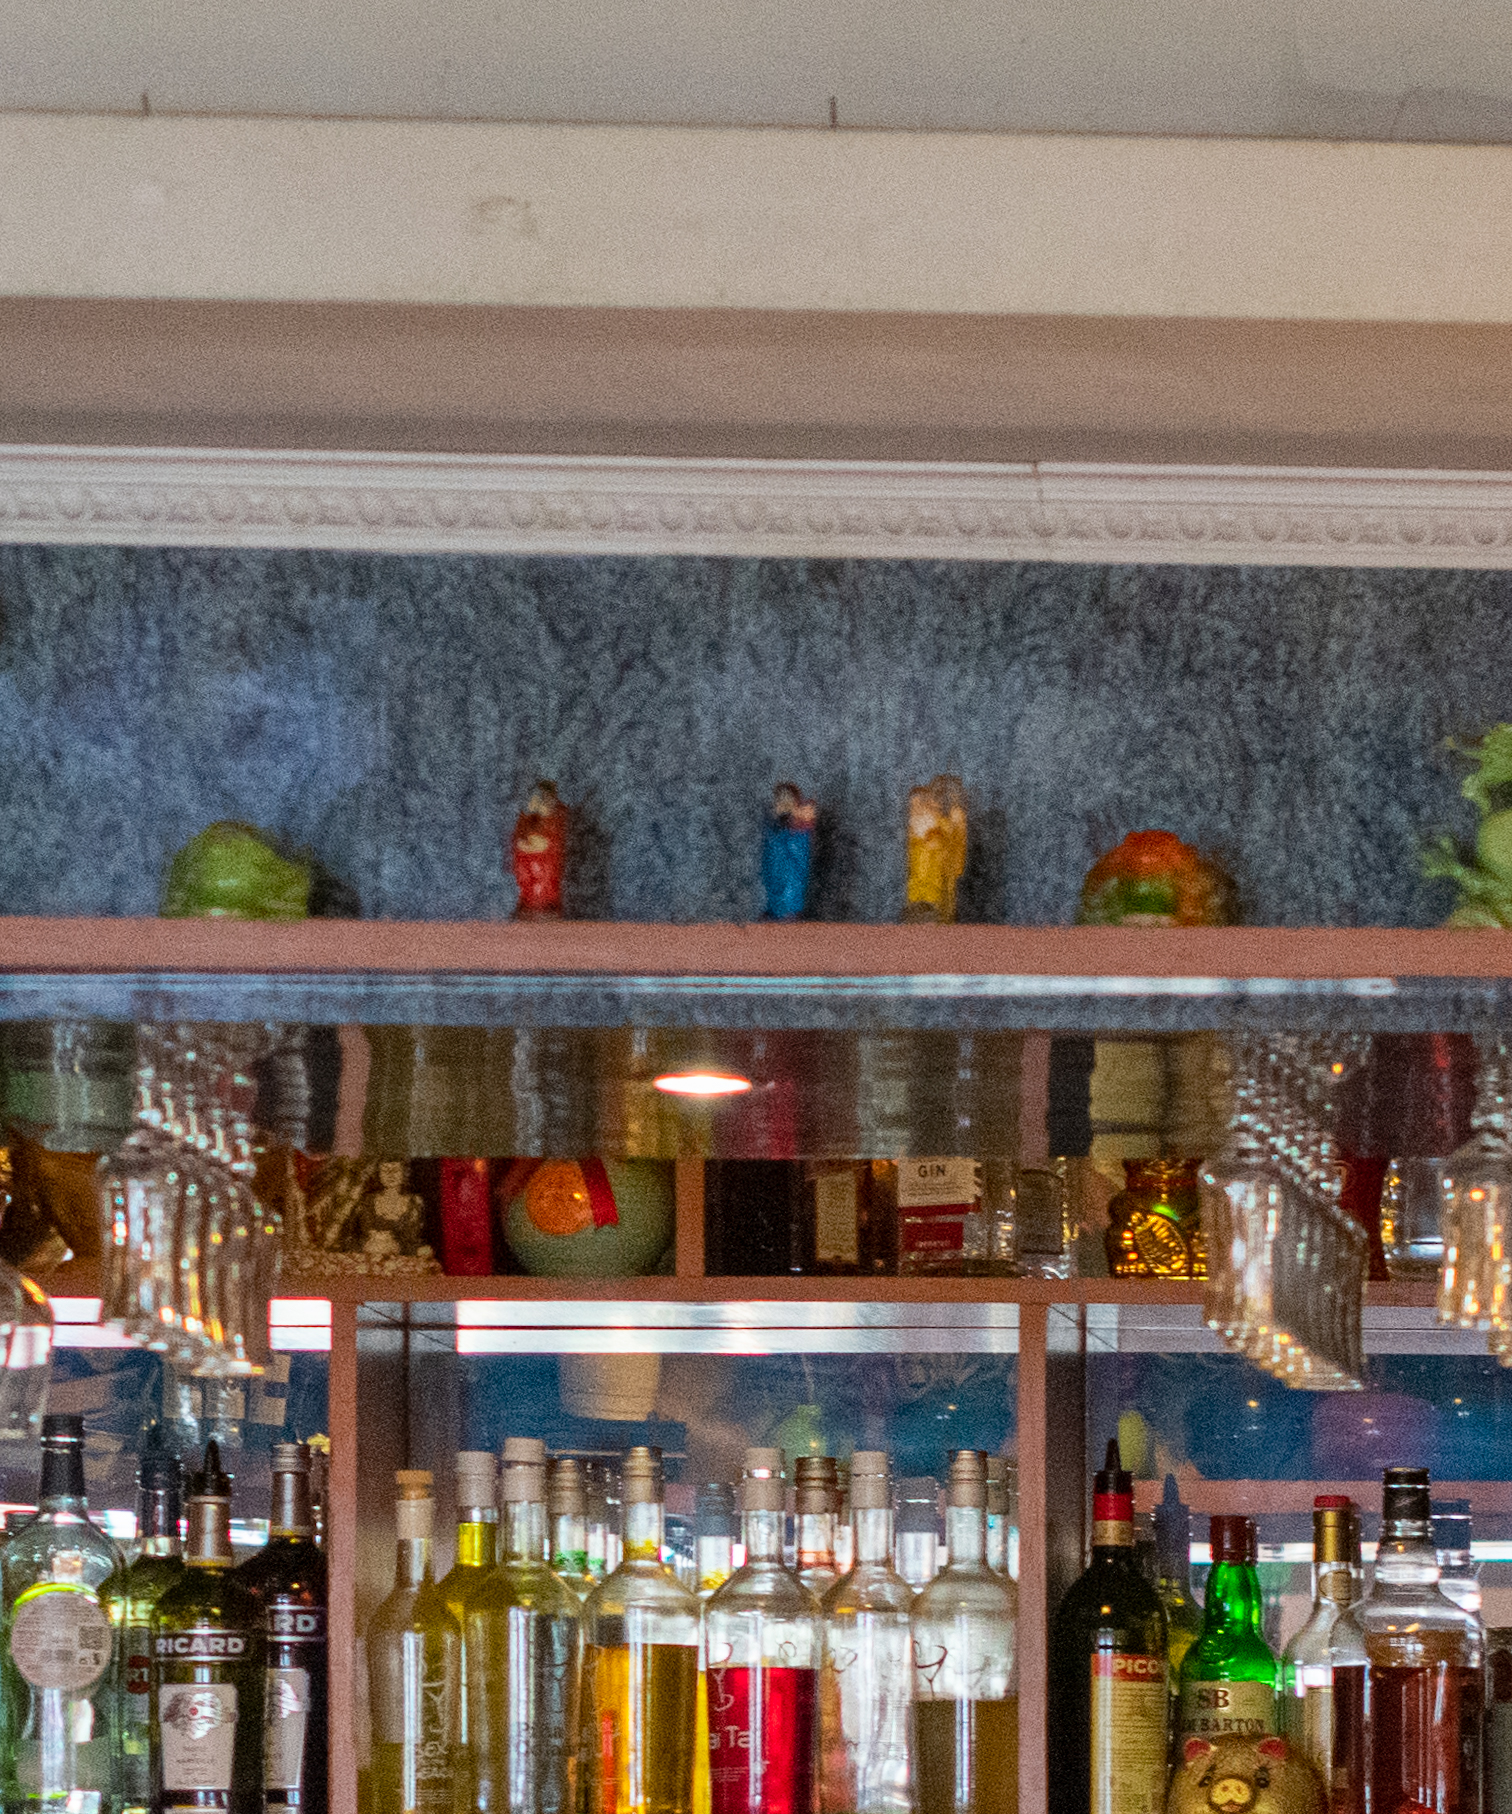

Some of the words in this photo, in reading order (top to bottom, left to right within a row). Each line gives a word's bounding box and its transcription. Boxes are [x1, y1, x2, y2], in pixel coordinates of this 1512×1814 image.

[917, 1165, 947, 1178] GIN
[155, 1637, 244, 1654] RICARD
[1112, 1658, 1158, 1675] PICO
[1201, 1717, 1265, 1732] BARTON
